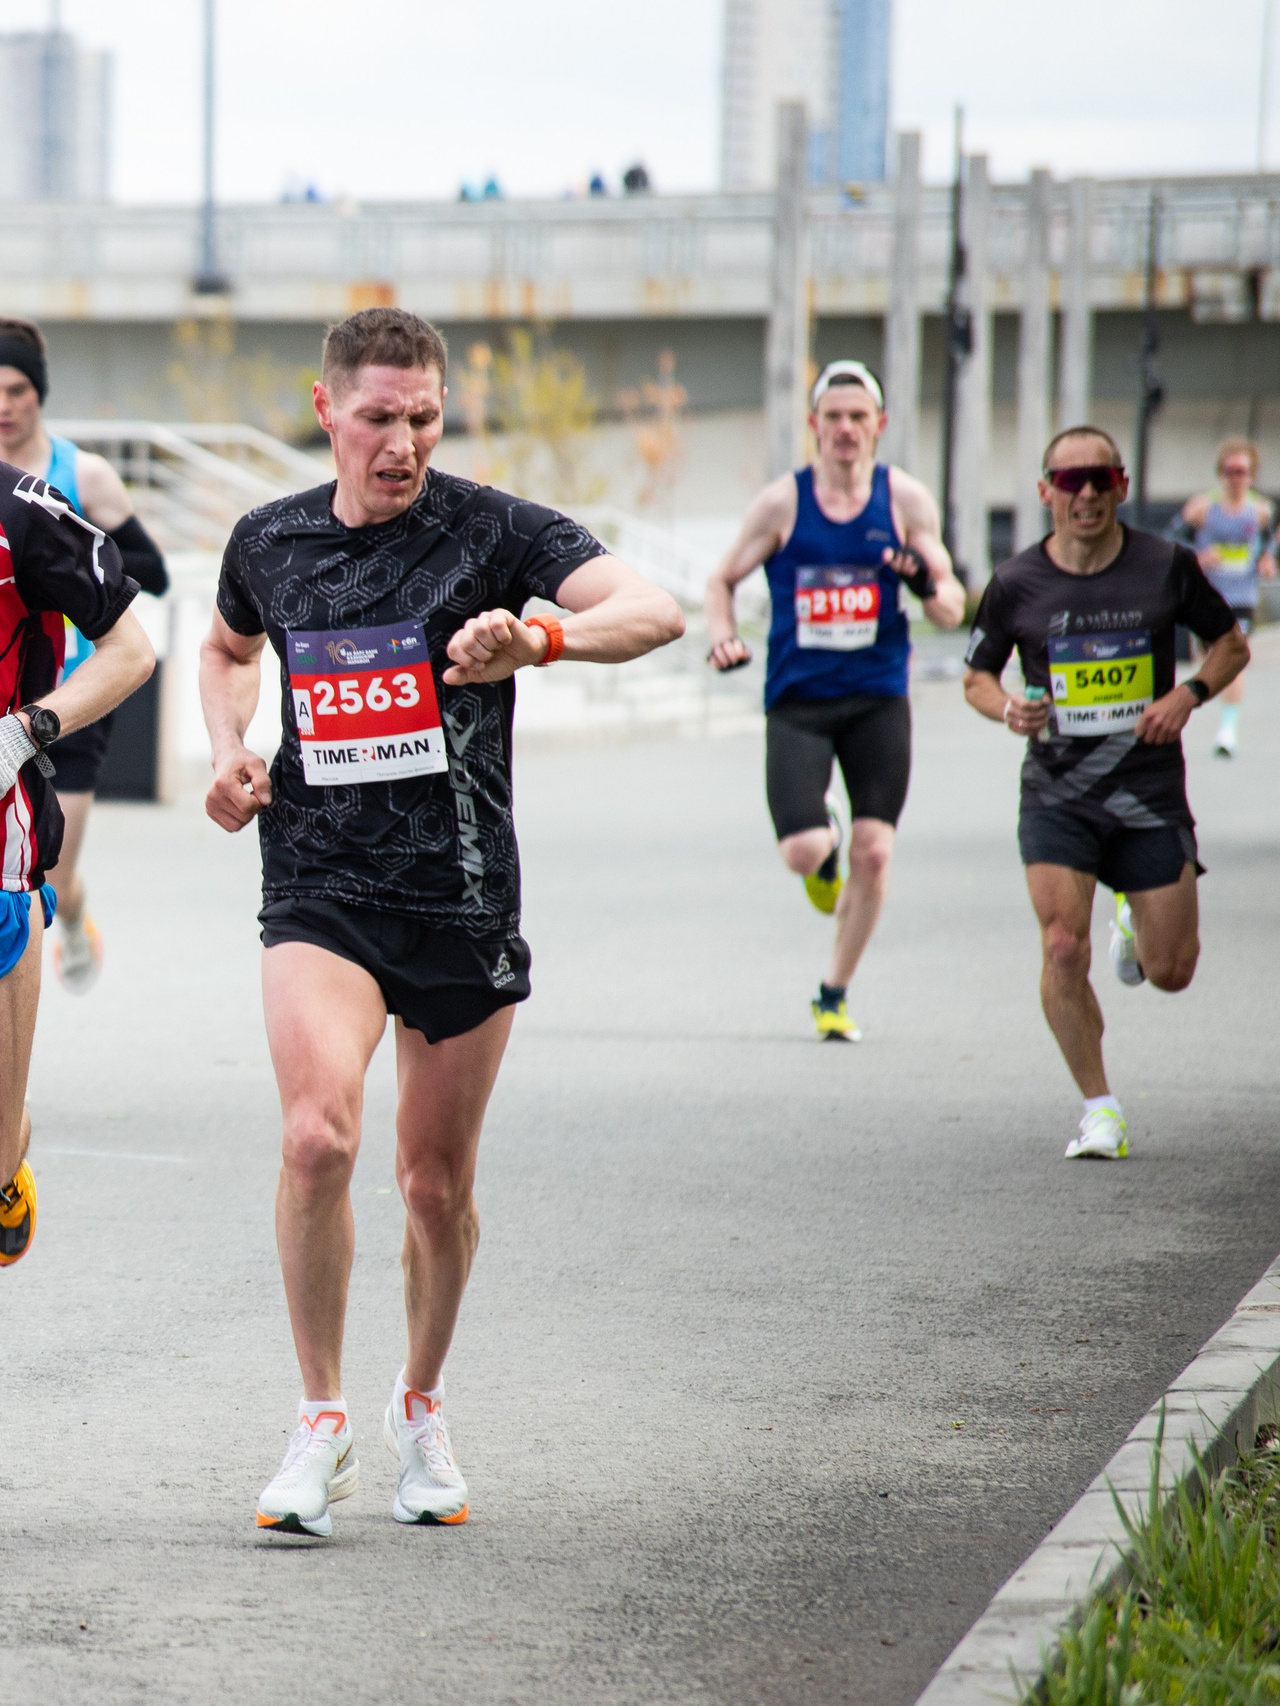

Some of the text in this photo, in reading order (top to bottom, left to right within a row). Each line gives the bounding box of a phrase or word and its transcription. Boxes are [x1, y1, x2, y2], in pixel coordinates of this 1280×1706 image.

[812, 586, 873, 615] 2100
[299, 672, 420, 718] A 2563
[1075, 664, 1137, 689] 5407
[449, 756, 485, 908] DEMIX
